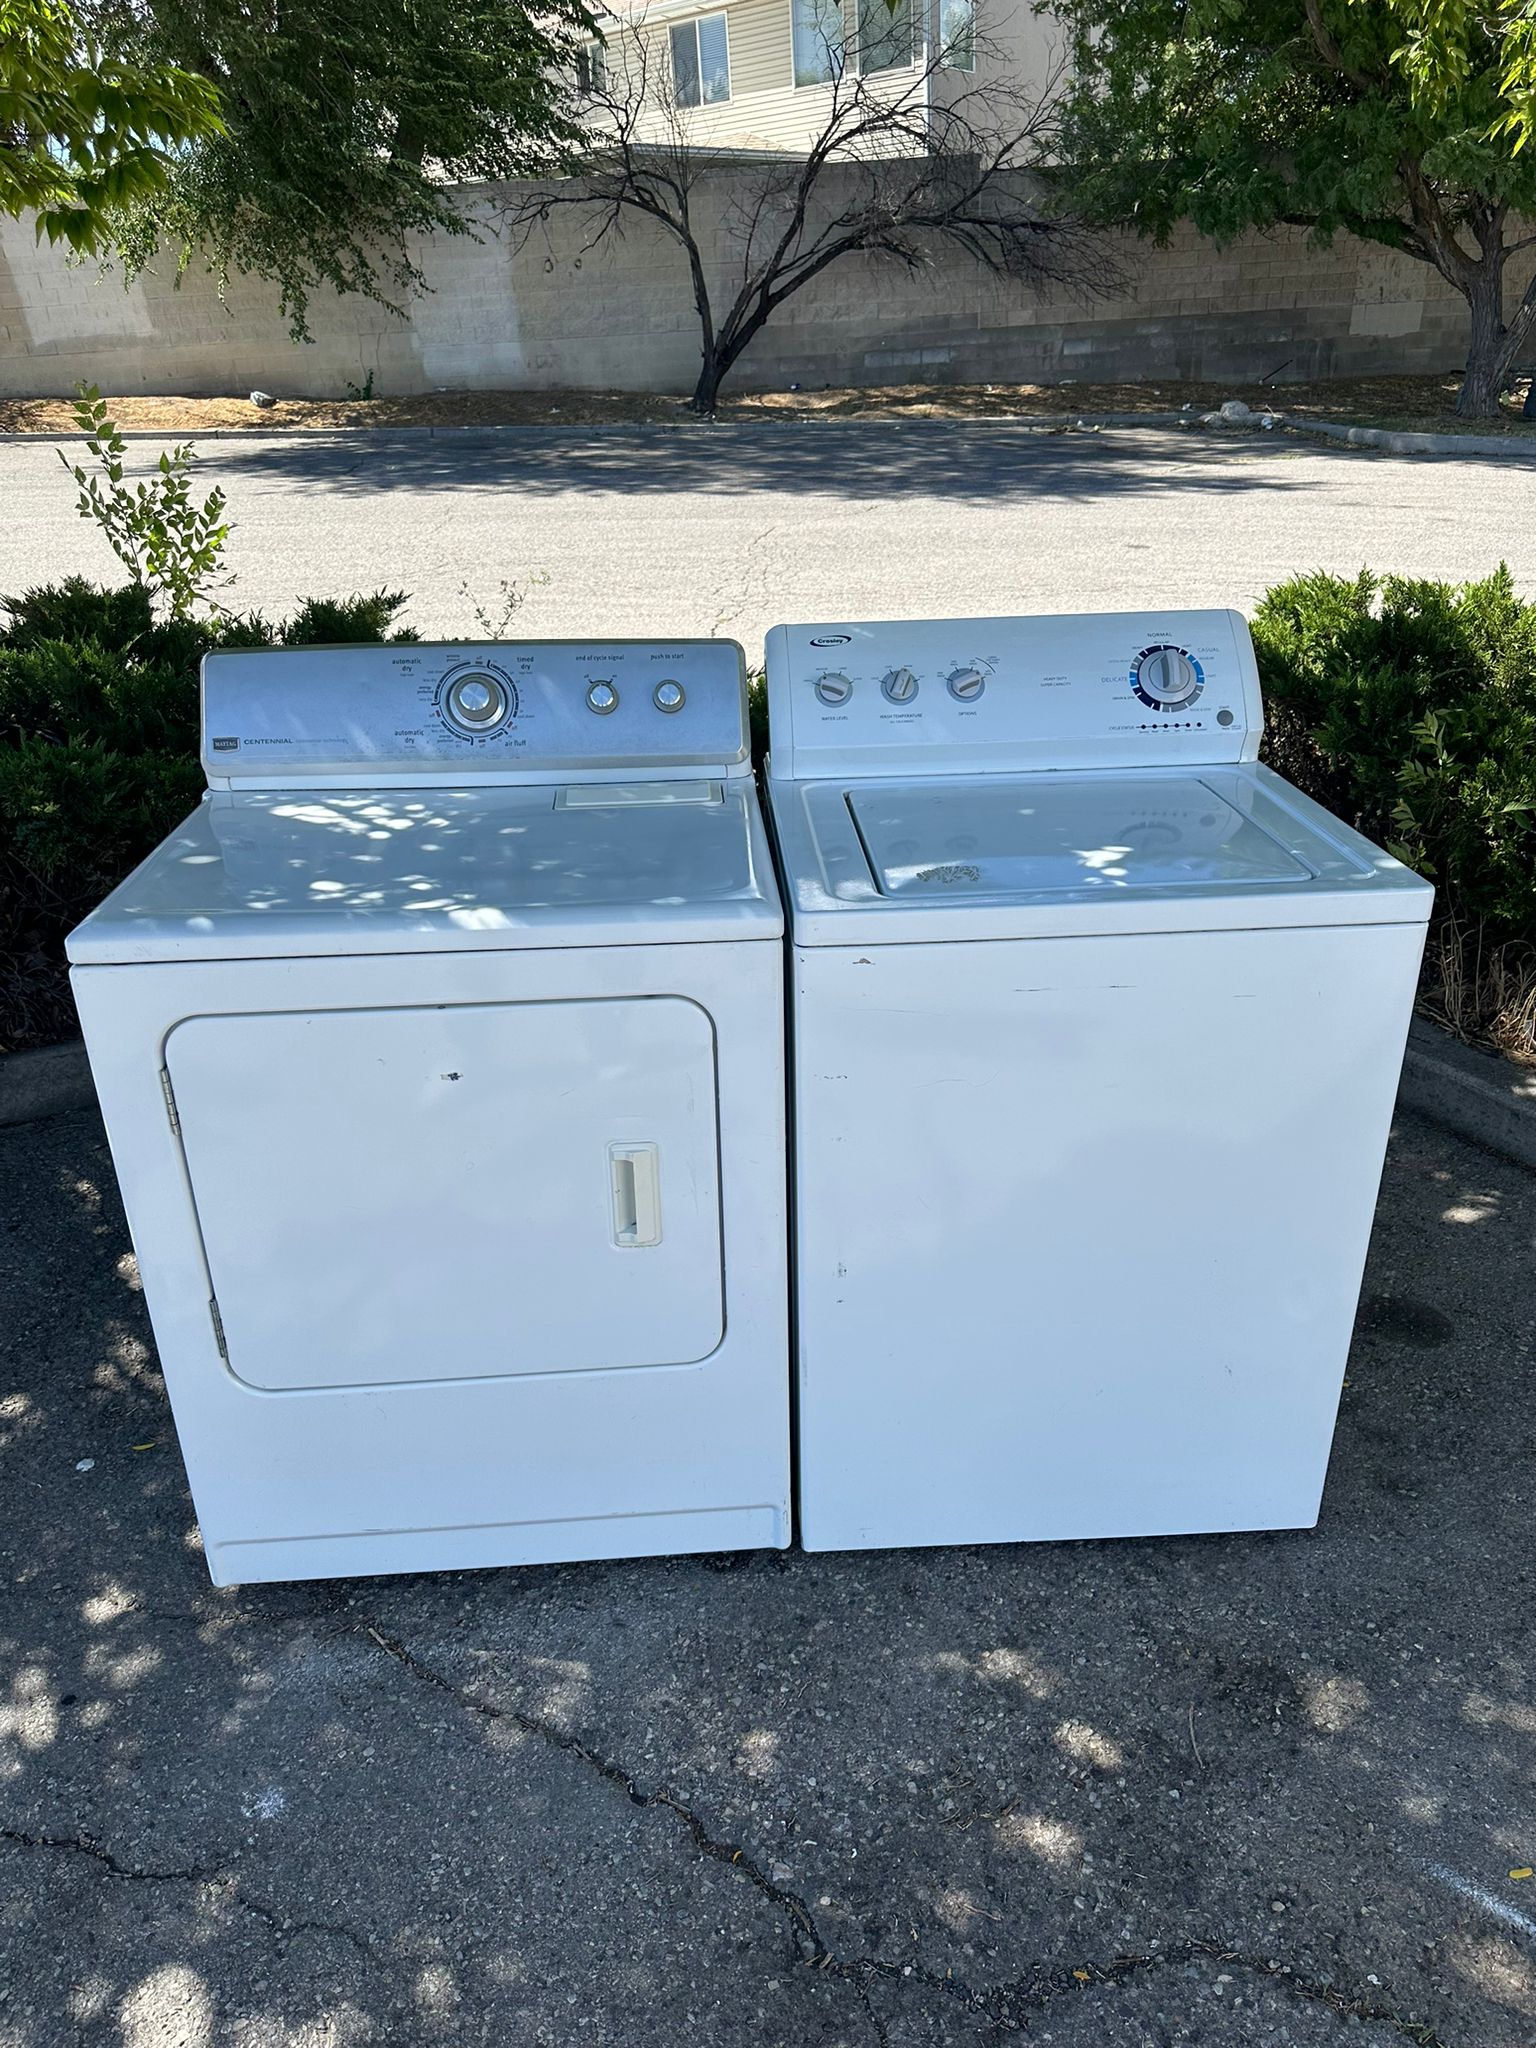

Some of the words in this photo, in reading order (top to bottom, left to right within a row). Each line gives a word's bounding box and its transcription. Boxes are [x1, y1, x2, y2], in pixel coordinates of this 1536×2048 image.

[392, 657, 422, 665] automatic
[608, 654, 625, 662] signal
[394, 729, 424, 737] automatic
[404, 737, 415, 745] dry
